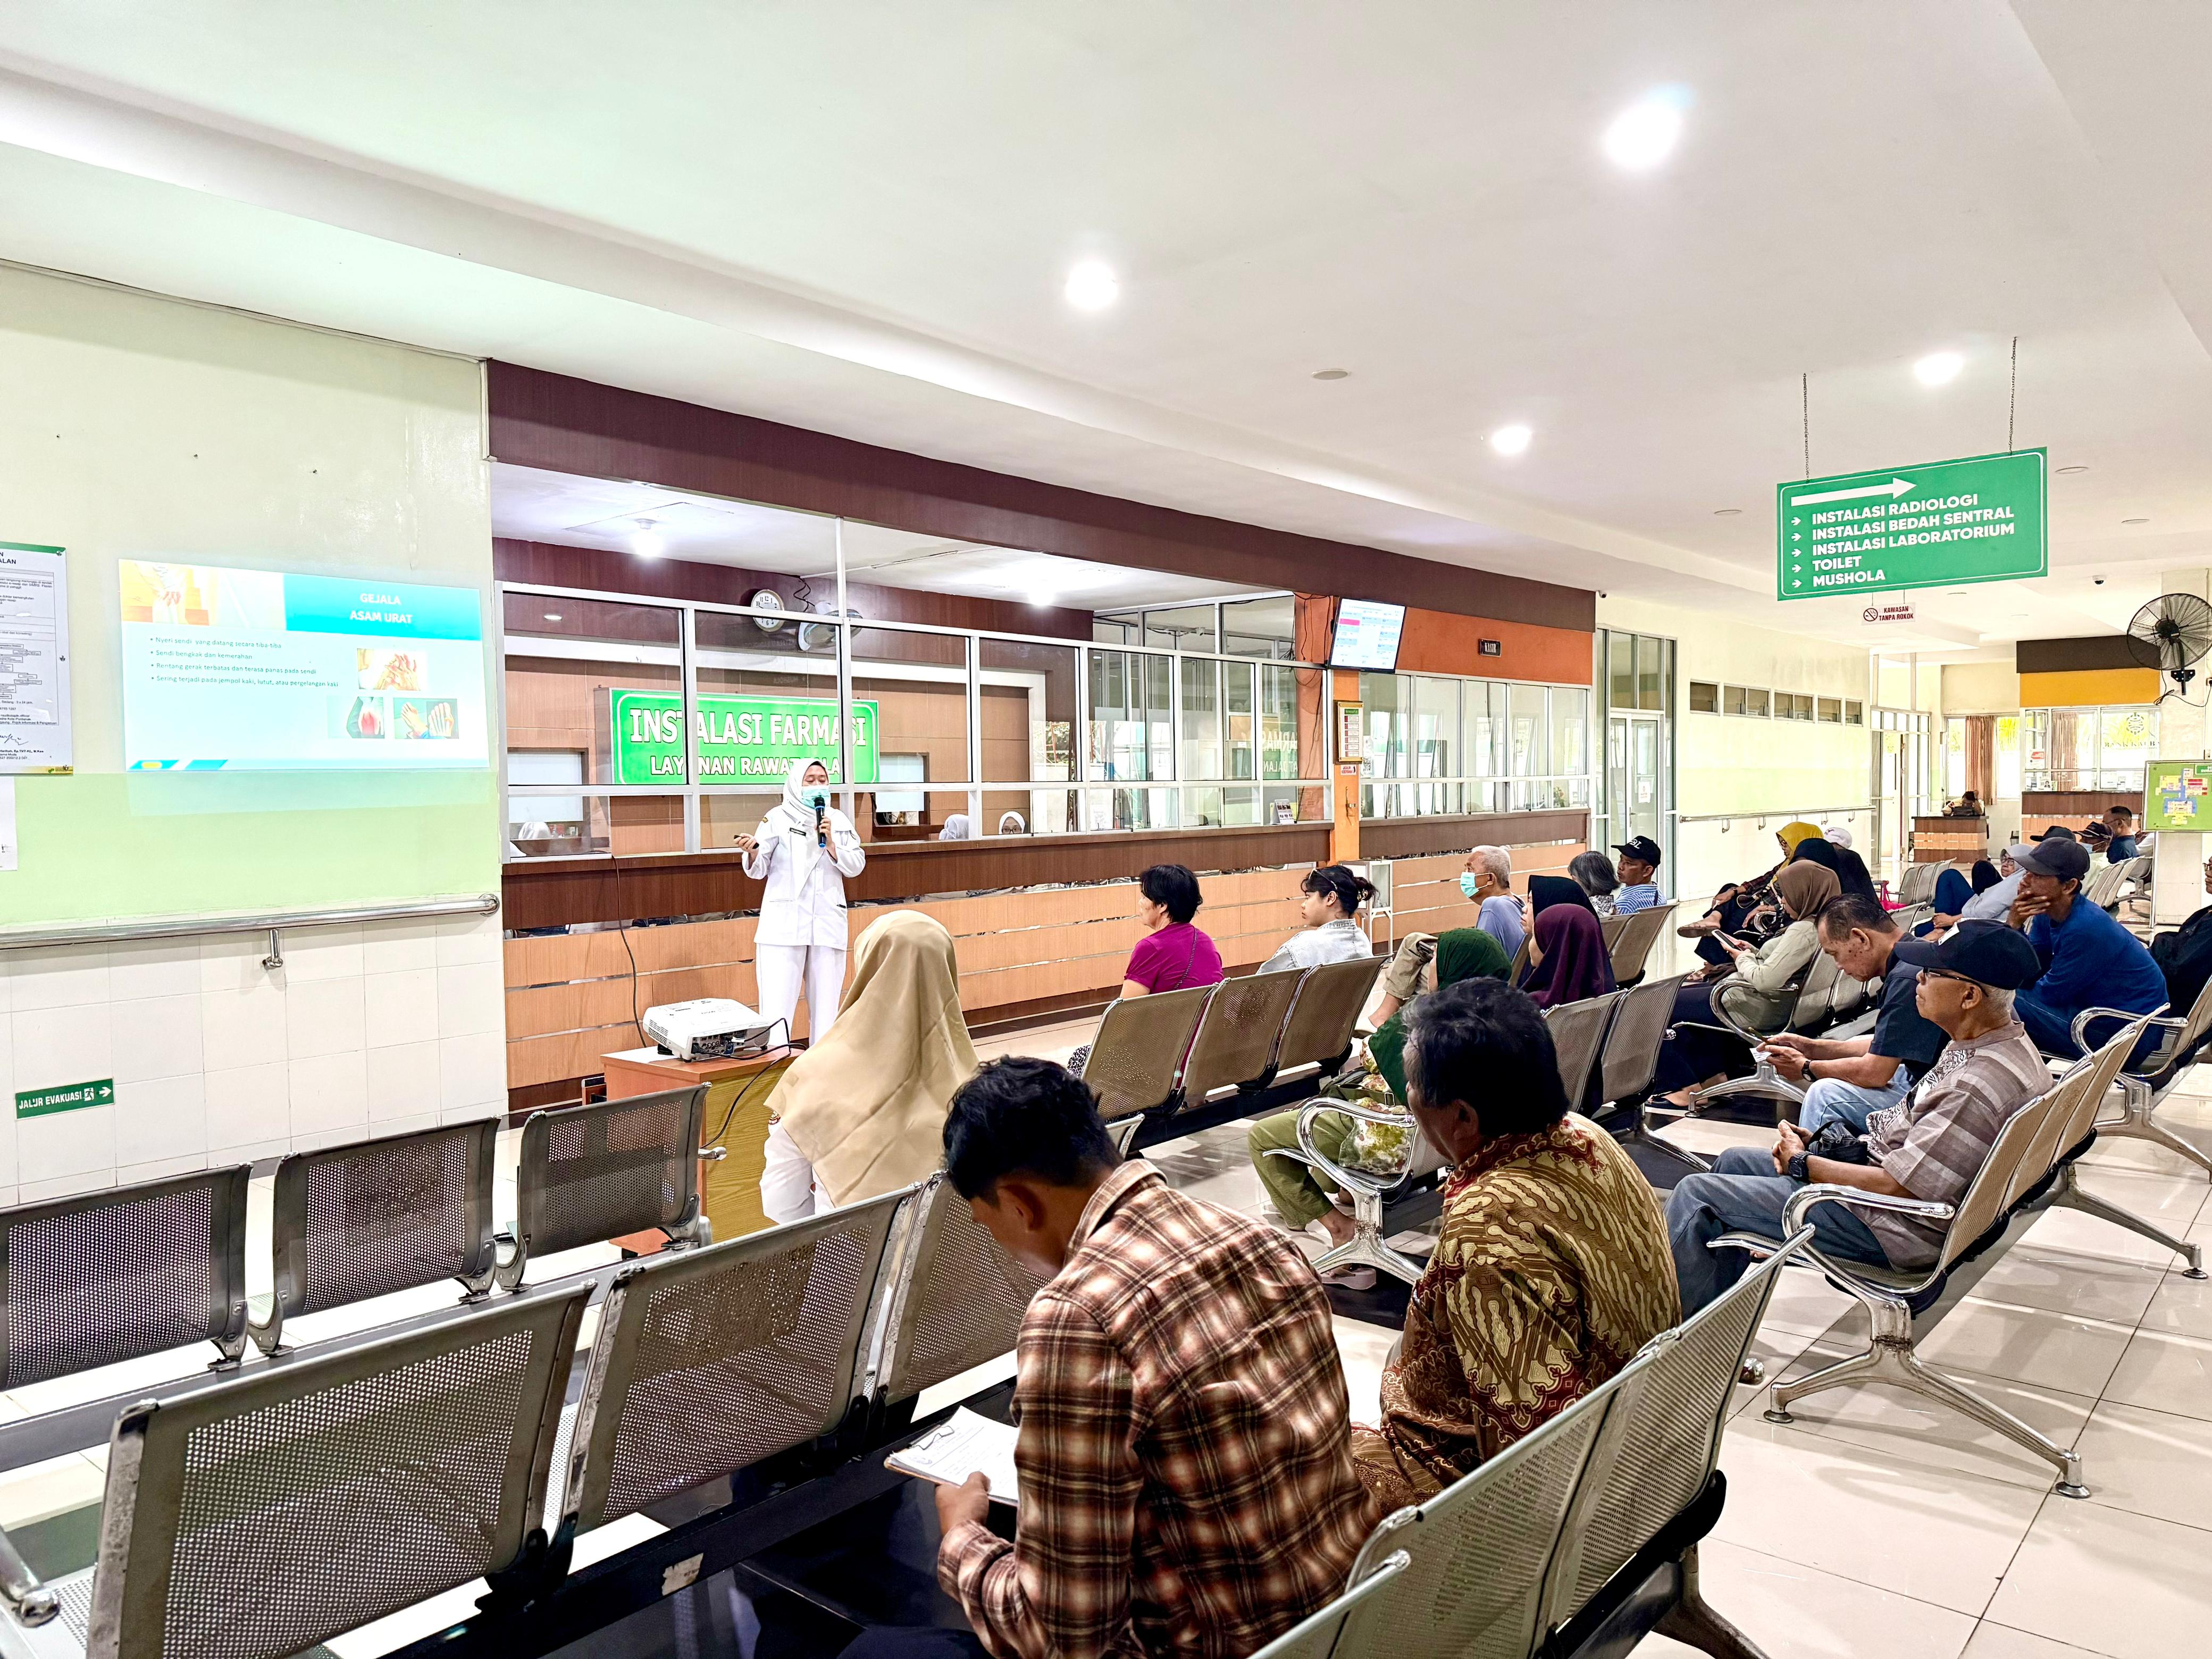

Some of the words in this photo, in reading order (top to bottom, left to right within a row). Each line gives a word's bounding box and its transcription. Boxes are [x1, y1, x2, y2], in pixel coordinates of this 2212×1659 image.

[1812, 505, 1885, 525] INSTALASI
[1888, 493, 1978, 515] RADIOLOGI
[1812, 521, 1886, 541] INSTALASI
[1889, 514, 1940, 532] BEDAH
[1943, 506, 2015, 525] SENTRAL
[1813, 537, 1886, 556] INSTALASI
[1889, 522, 2015, 548] LABORATORIUM
[1812, 555, 1862, 572] TOILET
[1813, 569, 1886, 587] MUSHOLA
[360, 593, 401, 605] GEJALA
[350, 610, 382, 622] ASAM
[384, 613, 413, 624] URAT
[630, 708, 763, 745] INSALASI
[650, 755, 735, 775] LAYNAN
[19, 1097, 44, 1110] JALUR
[45, 1091, 82, 1105] EVAKUASI
